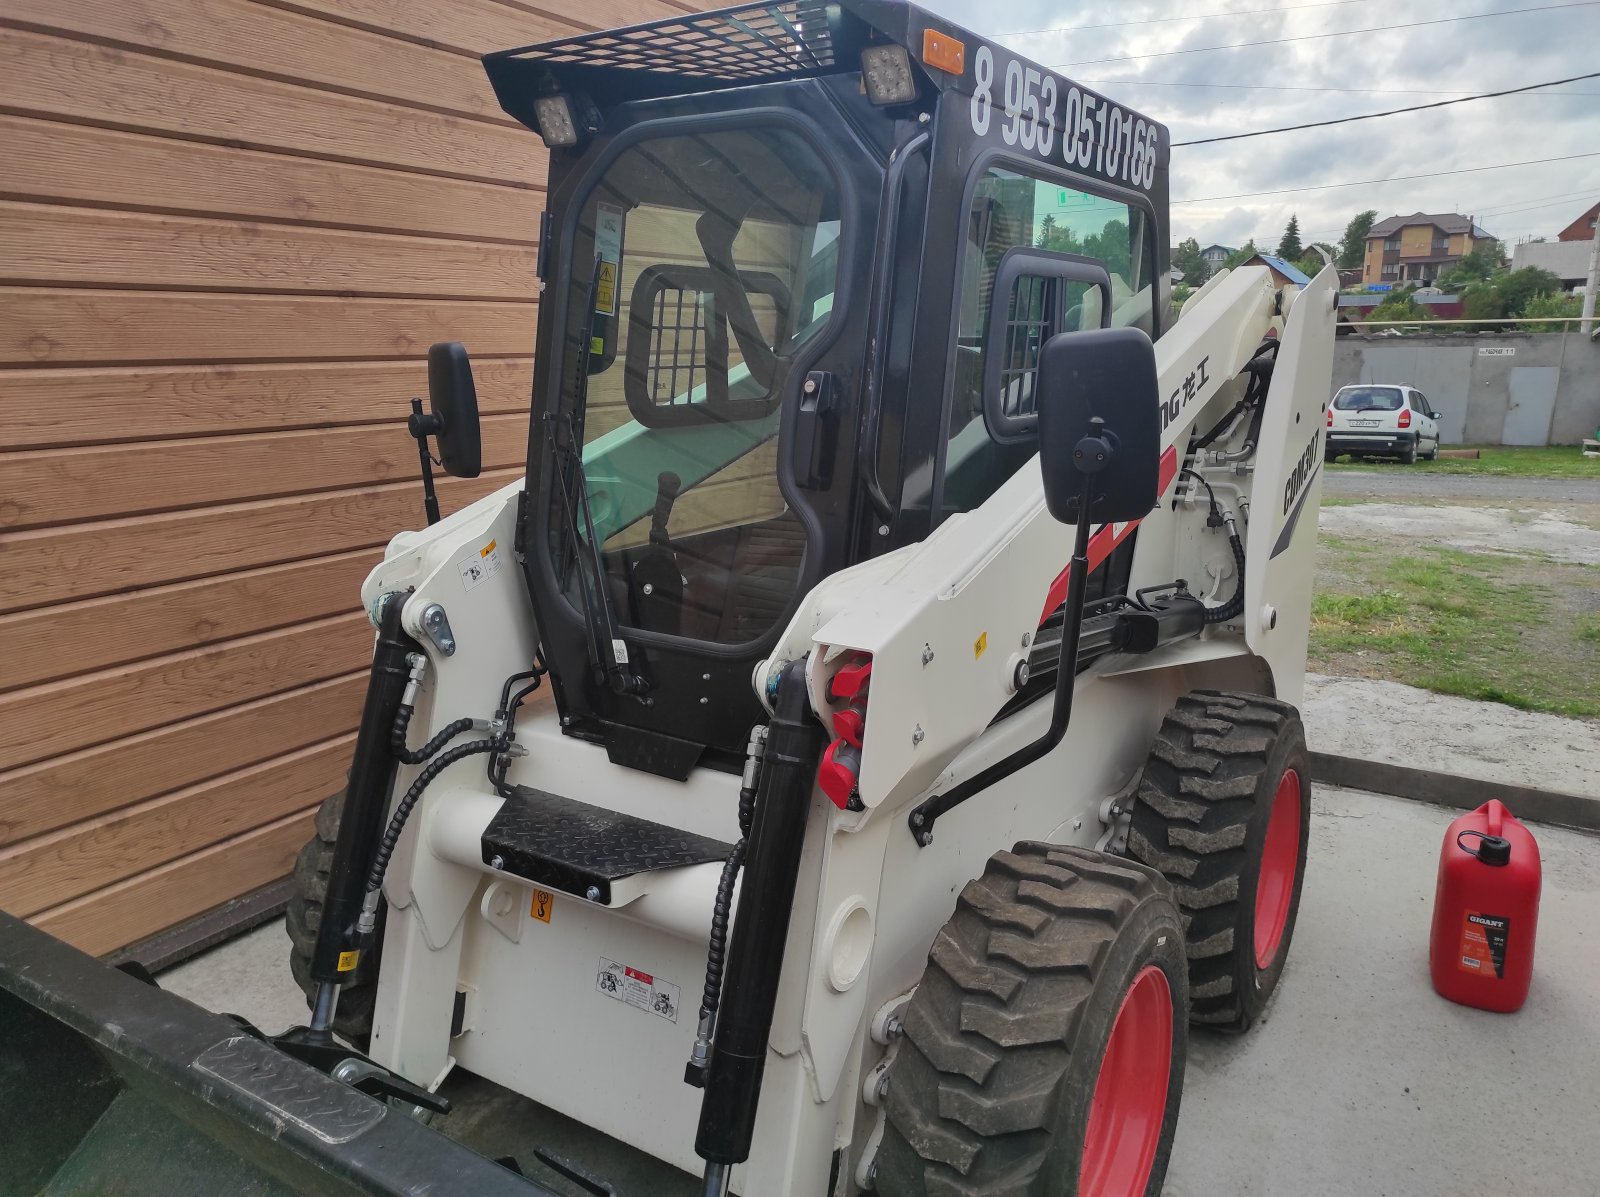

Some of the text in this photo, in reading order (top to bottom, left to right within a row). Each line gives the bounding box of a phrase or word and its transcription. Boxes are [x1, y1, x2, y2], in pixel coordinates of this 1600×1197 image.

[970, 46, 1158, 190] 8 953 0510166
[1283, 427, 1320, 516] CDM307
[1469, 915, 1504, 928] GIGANT
